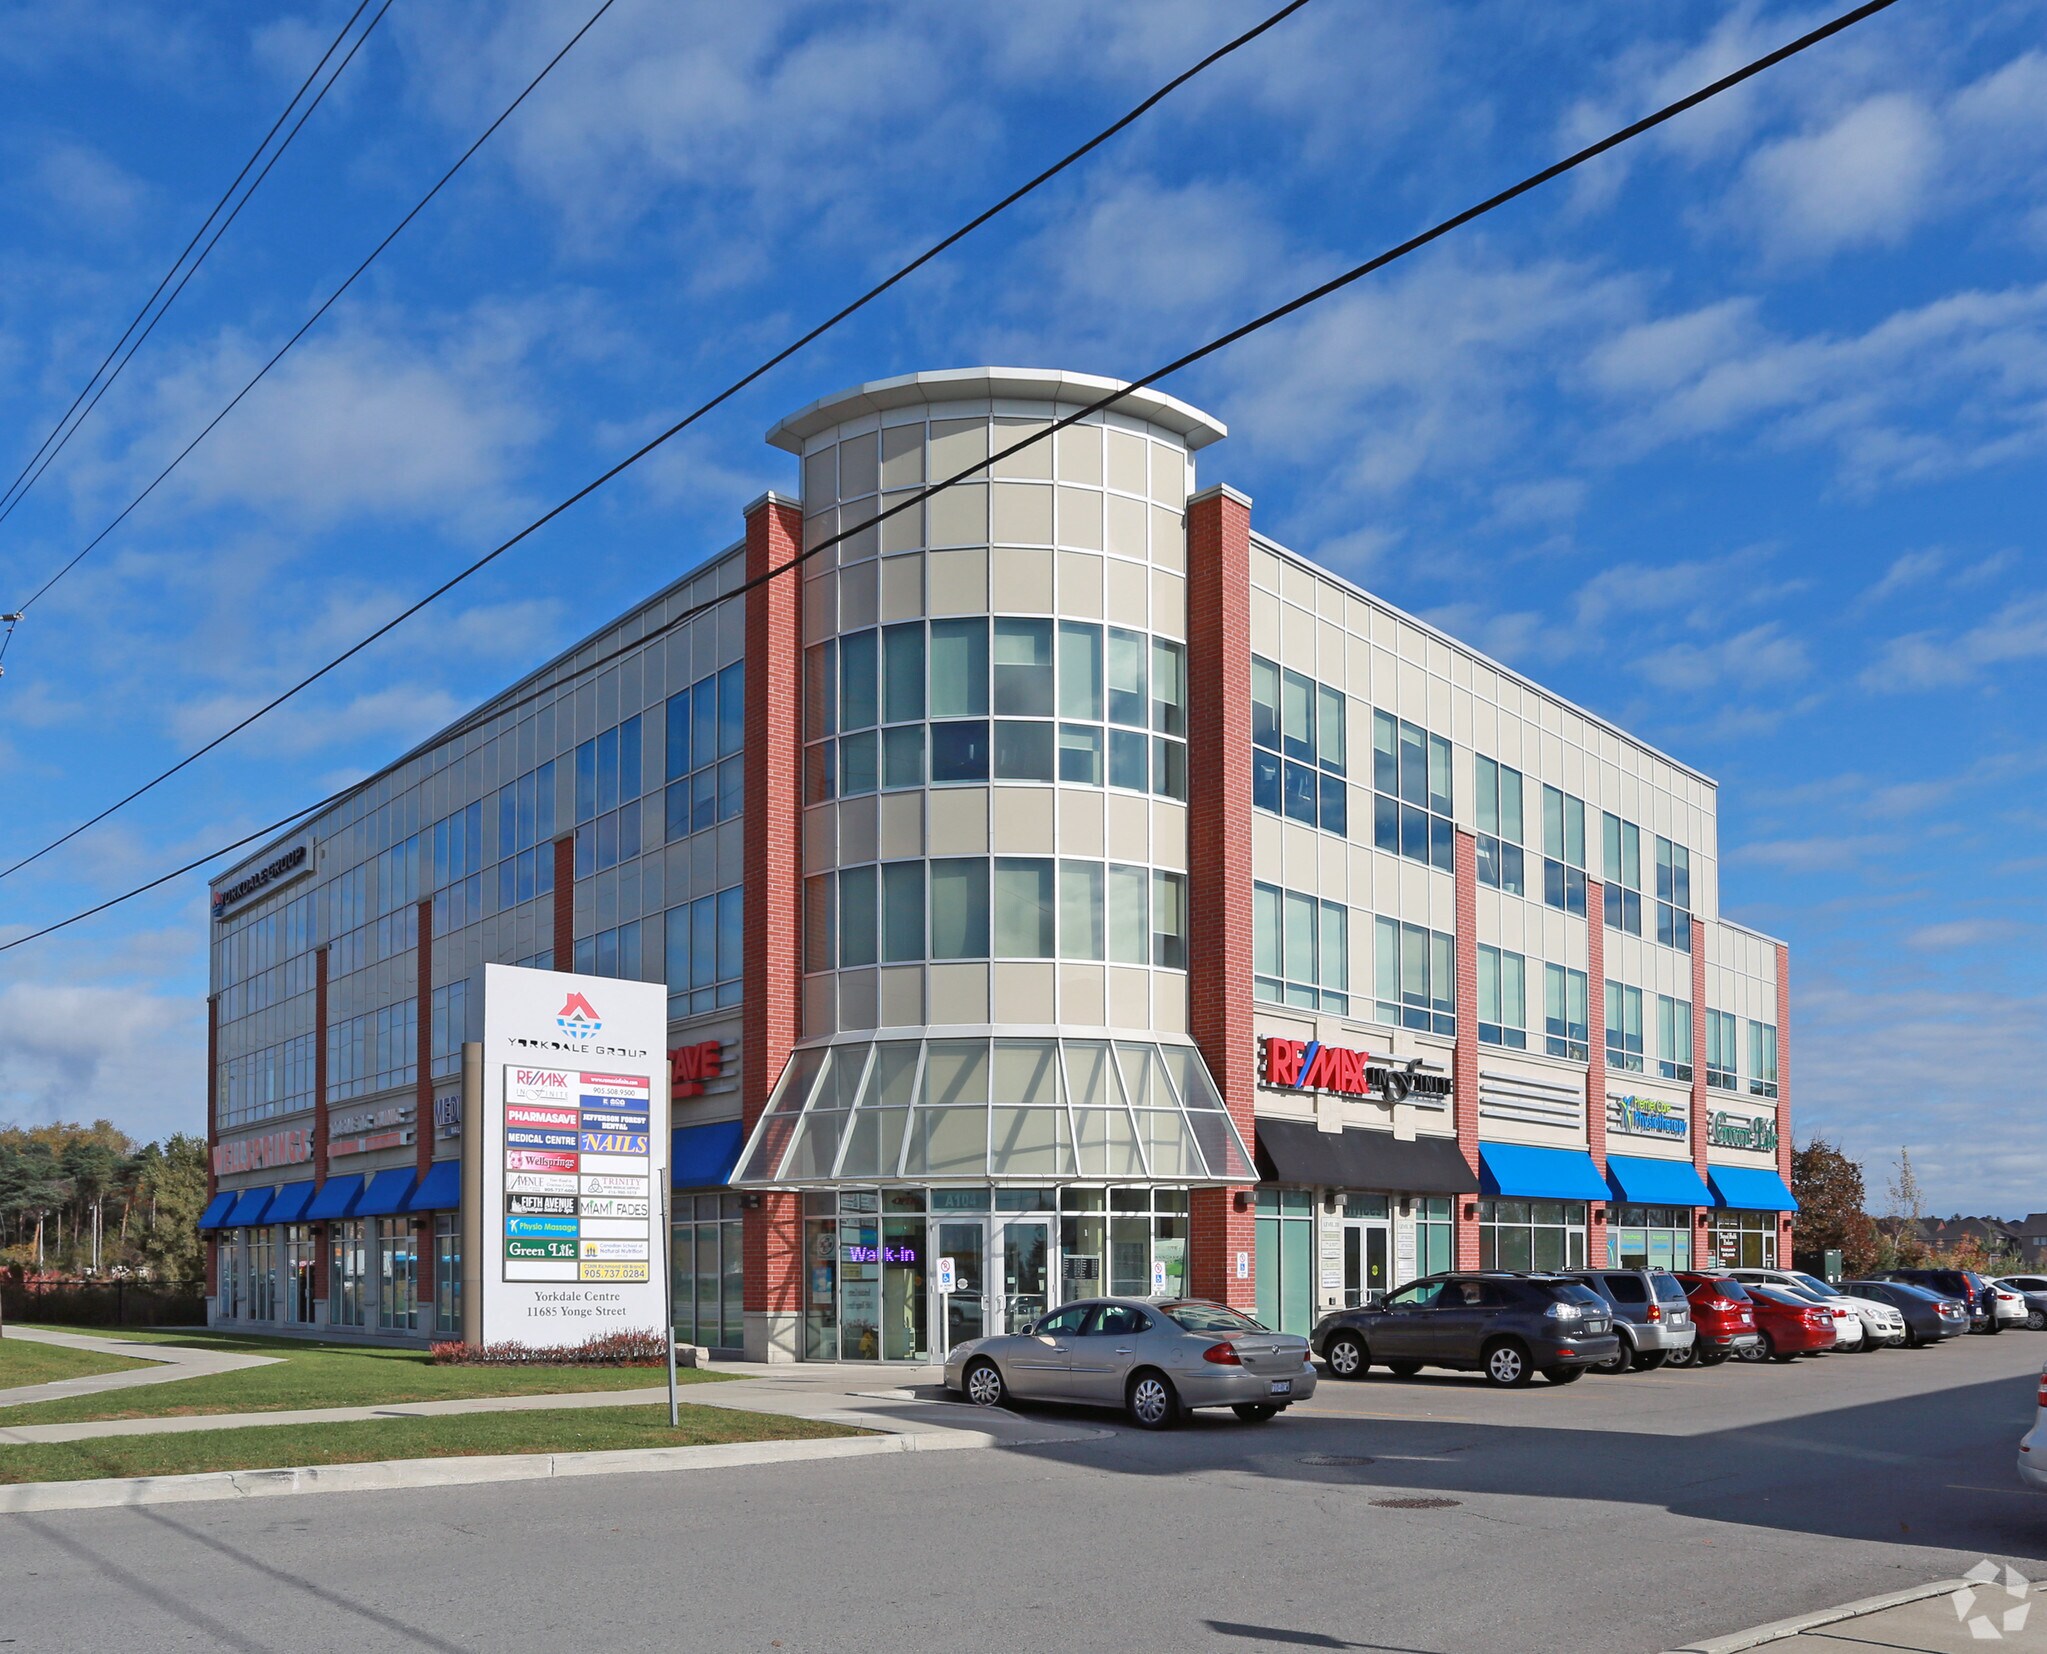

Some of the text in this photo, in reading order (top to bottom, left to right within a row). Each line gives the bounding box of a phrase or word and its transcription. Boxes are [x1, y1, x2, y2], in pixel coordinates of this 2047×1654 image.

[222, 846, 307, 906] YORKDALE GROUP
[508, 1037, 647, 1058] YORKDALE GROUP
[668, 1040, 720, 1083] AVE
[1266, 1037, 1371, 1094] RE/MAX
[517, 1069, 568, 1088] RE/MAX
[593, 1087, 635, 1097] 905.508.9500
[508, 1110, 577, 1125] PHARMASAVE
[583, 1113, 646, 1124] JEFFERSON FOREST
[1634, 1110, 1687, 1136] Physiotherapy
[602, 1122, 628, 1130] DENTAL
[1712, 1110, 1751, 1145] Green
[508, 1133, 543, 1144] MEDICAL
[545, 1135, 576, 1146] CENTRE
[584, 1133, 648, 1154] NAILS
[213, 1128, 312, 1176] WELLSPRINGS
[525, 1155, 575, 1168] Wellsprings
[602, 1177, 641, 1186] TRINITY
[521, 1196, 574, 1209] FIFTH AVENUE
[581, 1200, 648, 1216] MIAMI FADES
[520, 1222, 577, 1232] Physio Massage
[509, 1242, 575, 1257] Green Life
[849, 1246, 915, 1262] Walk-in
[584, 1269, 645, 1279] 905.737.0284
[535, 1290, 620, 1301] Yorkdale Centre
[527, 1306, 626, 1318] 11685 Yonge Street
